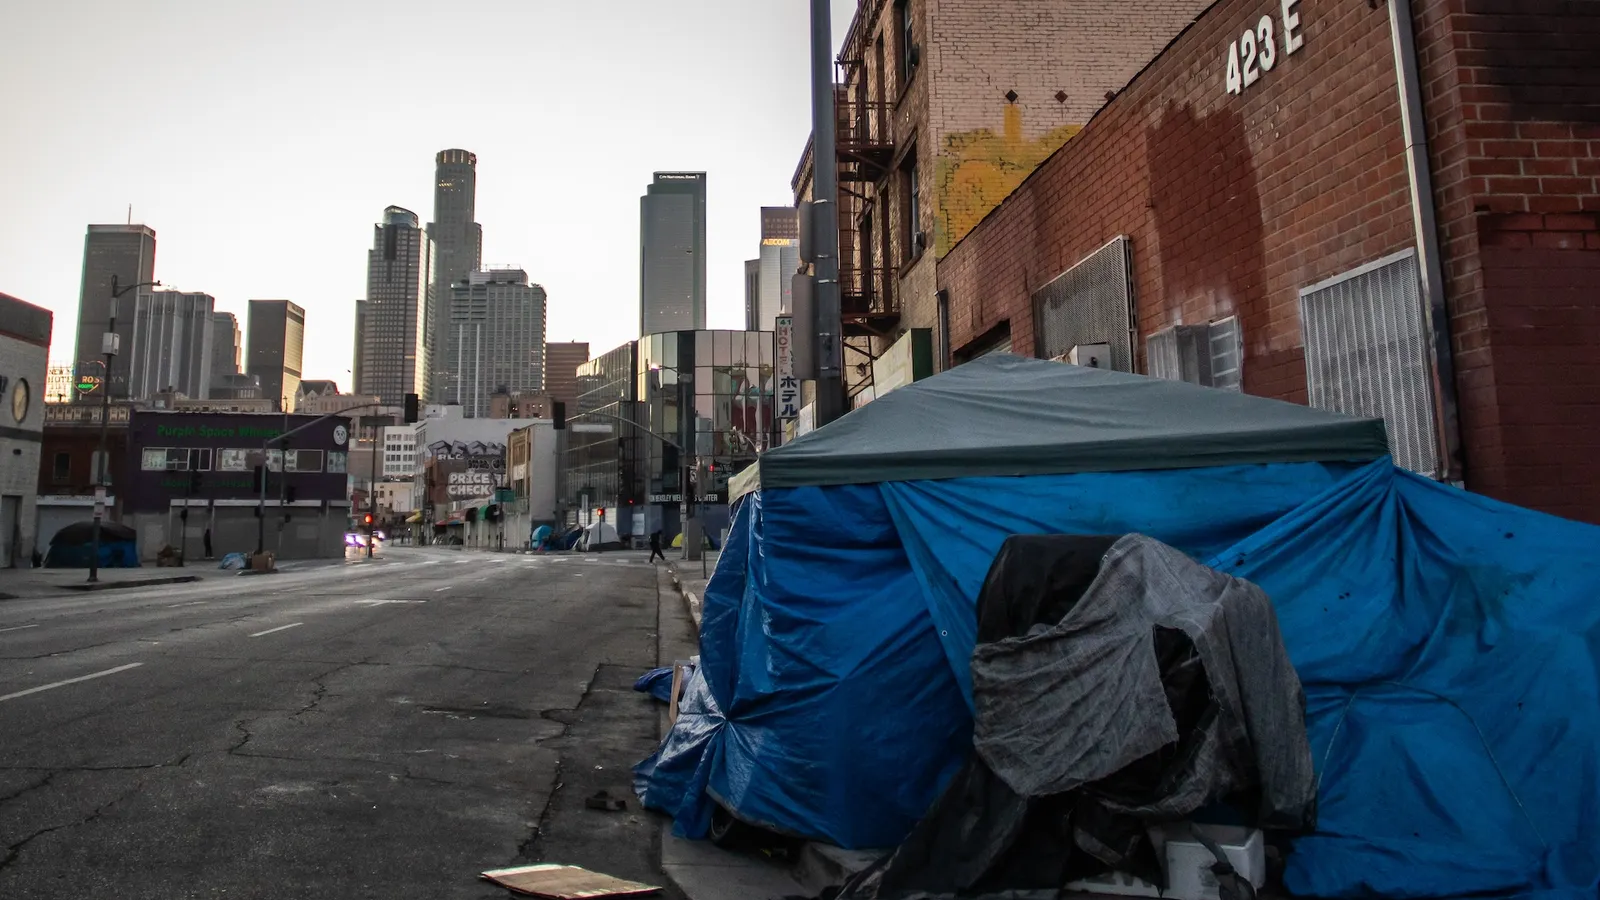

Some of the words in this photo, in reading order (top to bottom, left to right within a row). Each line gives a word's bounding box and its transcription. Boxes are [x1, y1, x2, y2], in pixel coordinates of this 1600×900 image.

[1226, 14, 1276, 95] 423
[1281, 0, 1303, 55] E
[762, 238, 790, 246] AECOM
[779, 327, 788, 375] HOTEL
[780, 376, 798, 417] ホテル
[157, 424, 195, 439] Purple
[199, 424, 235, 439] Space
[450, 473, 490, 484] PRICE
[448, 485, 490, 495] CHECK
